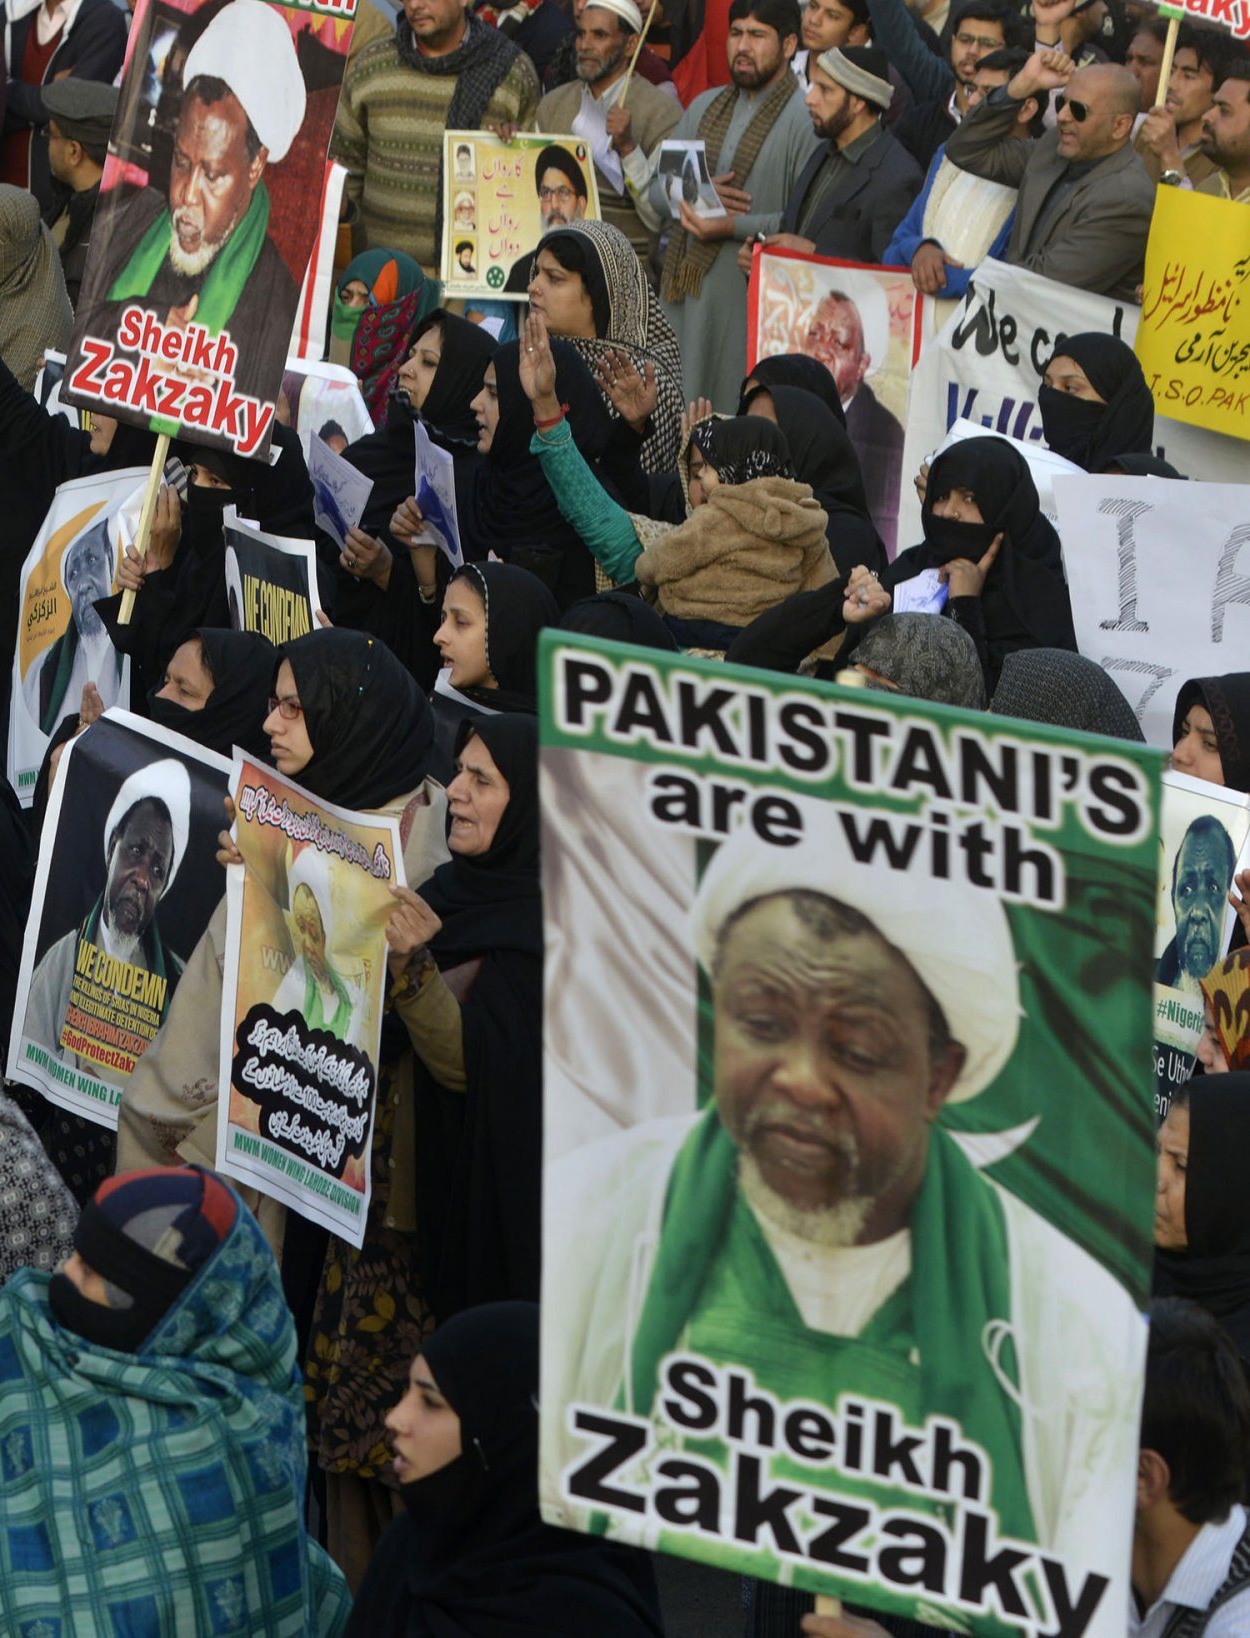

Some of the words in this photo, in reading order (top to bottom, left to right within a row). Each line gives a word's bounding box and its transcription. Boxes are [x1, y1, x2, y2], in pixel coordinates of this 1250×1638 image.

[119, 308, 237, 376] Sheikh
[952, 280, 1019, 366] We
[71, 339, 275, 453] Zakzaky
[244, 573, 260, 633] WE
[260, 580, 311, 648] CONDEMN
[561, 658, 1144, 837] PAKISTANI'S
[650, 770, 804, 848] are
[837, 808, 1057, 902] with
[70, 990, 80, 1006] AND
[117, 1013, 149, 1038] DETENTION
[77, 939, 98, 981] WE
[95, 950, 168, 1011] CONDEMN
[82, 979, 102, 1002] KILLINGS
[102, 991, 111, 1005] OF
[112, 995, 129, 1014] SHIAS
[130, 1004, 139, 1017] IN
[138, 1005, 160, 1027] NIGERIA
[85, 1014, 118, 1047] IBRAHIM
[26, 1044, 50, 1070] MWM
[48, 1058, 77, 1088] WOMEN
[78, 1076, 108, 1102] WING
[234, 1132, 261, 1158] MWM
[261, 1143, 288, 1173] WOMEN
[286, 1159, 306, 1184] WING
[304, 1170, 331, 1198] LAHORE
[330, 1183, 361, 1216] DIVISION
[662, 1360, 983, 1501] Sheikh
[567, 1409, 1111, 1638] Zakzaky
